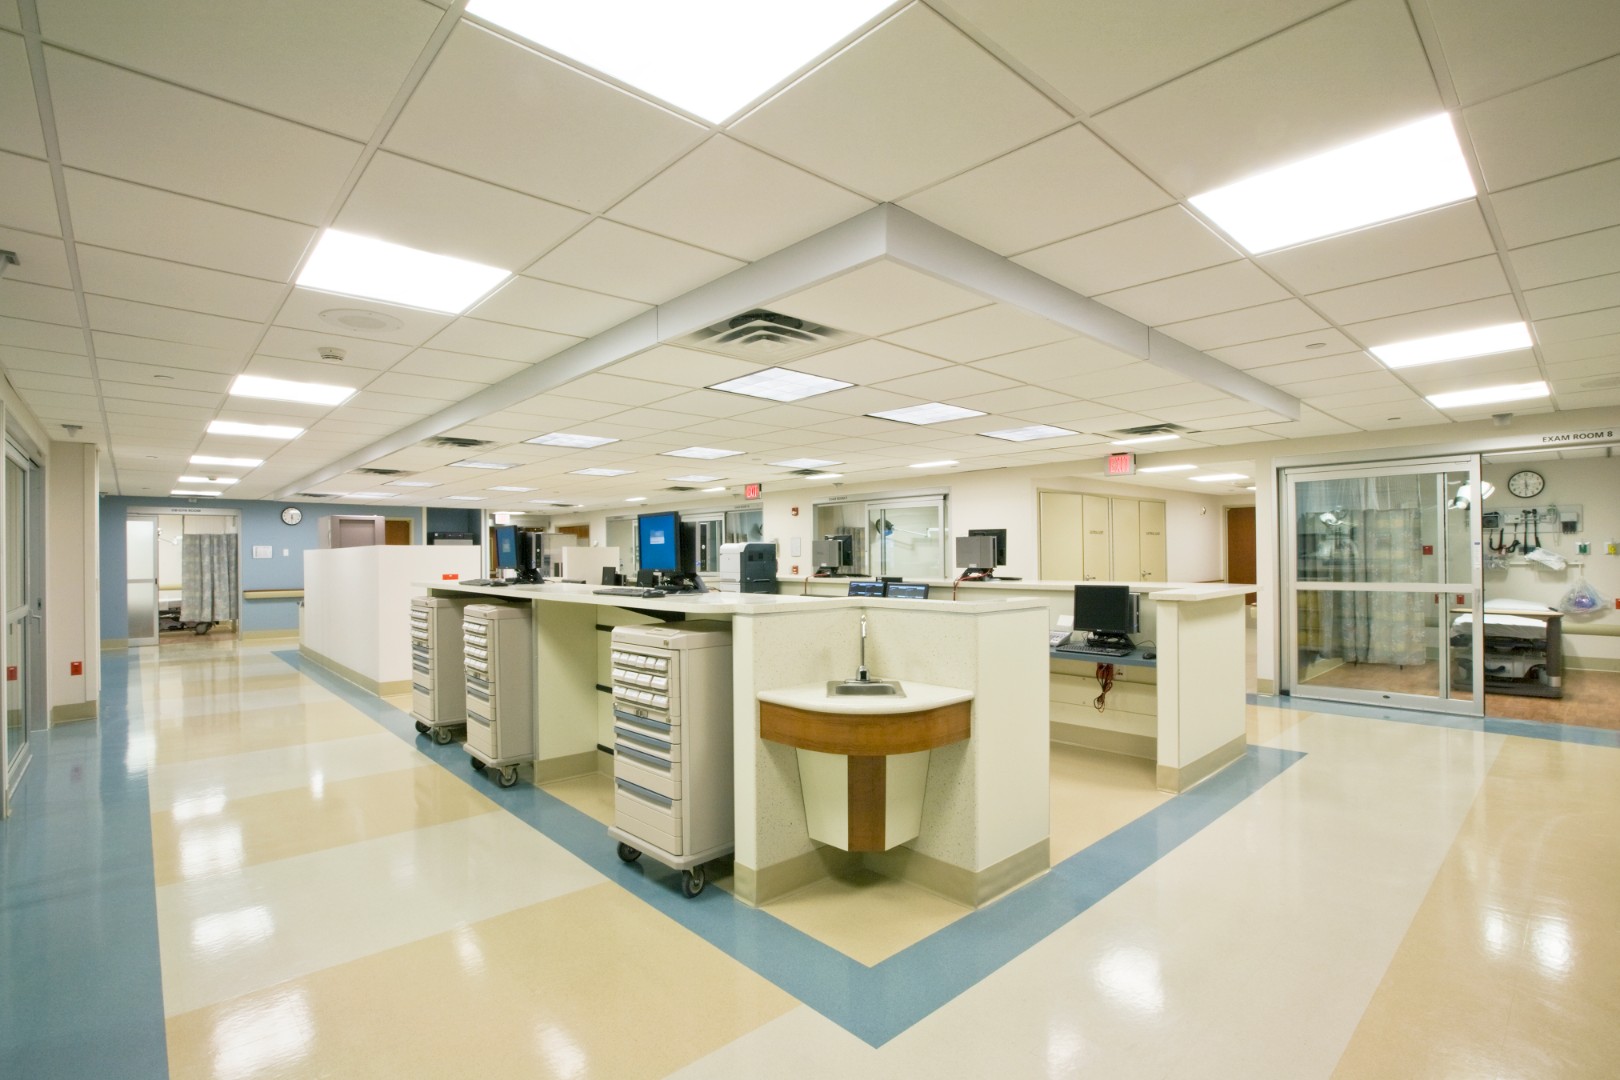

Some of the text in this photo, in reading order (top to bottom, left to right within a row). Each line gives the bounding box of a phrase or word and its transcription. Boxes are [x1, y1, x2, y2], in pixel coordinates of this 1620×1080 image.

[1542, 430, 1613, 443] EXAM ROOM 8
[1110, 456, 1129, 473] EXIT
[746, 485, 758, 498] EXIT
